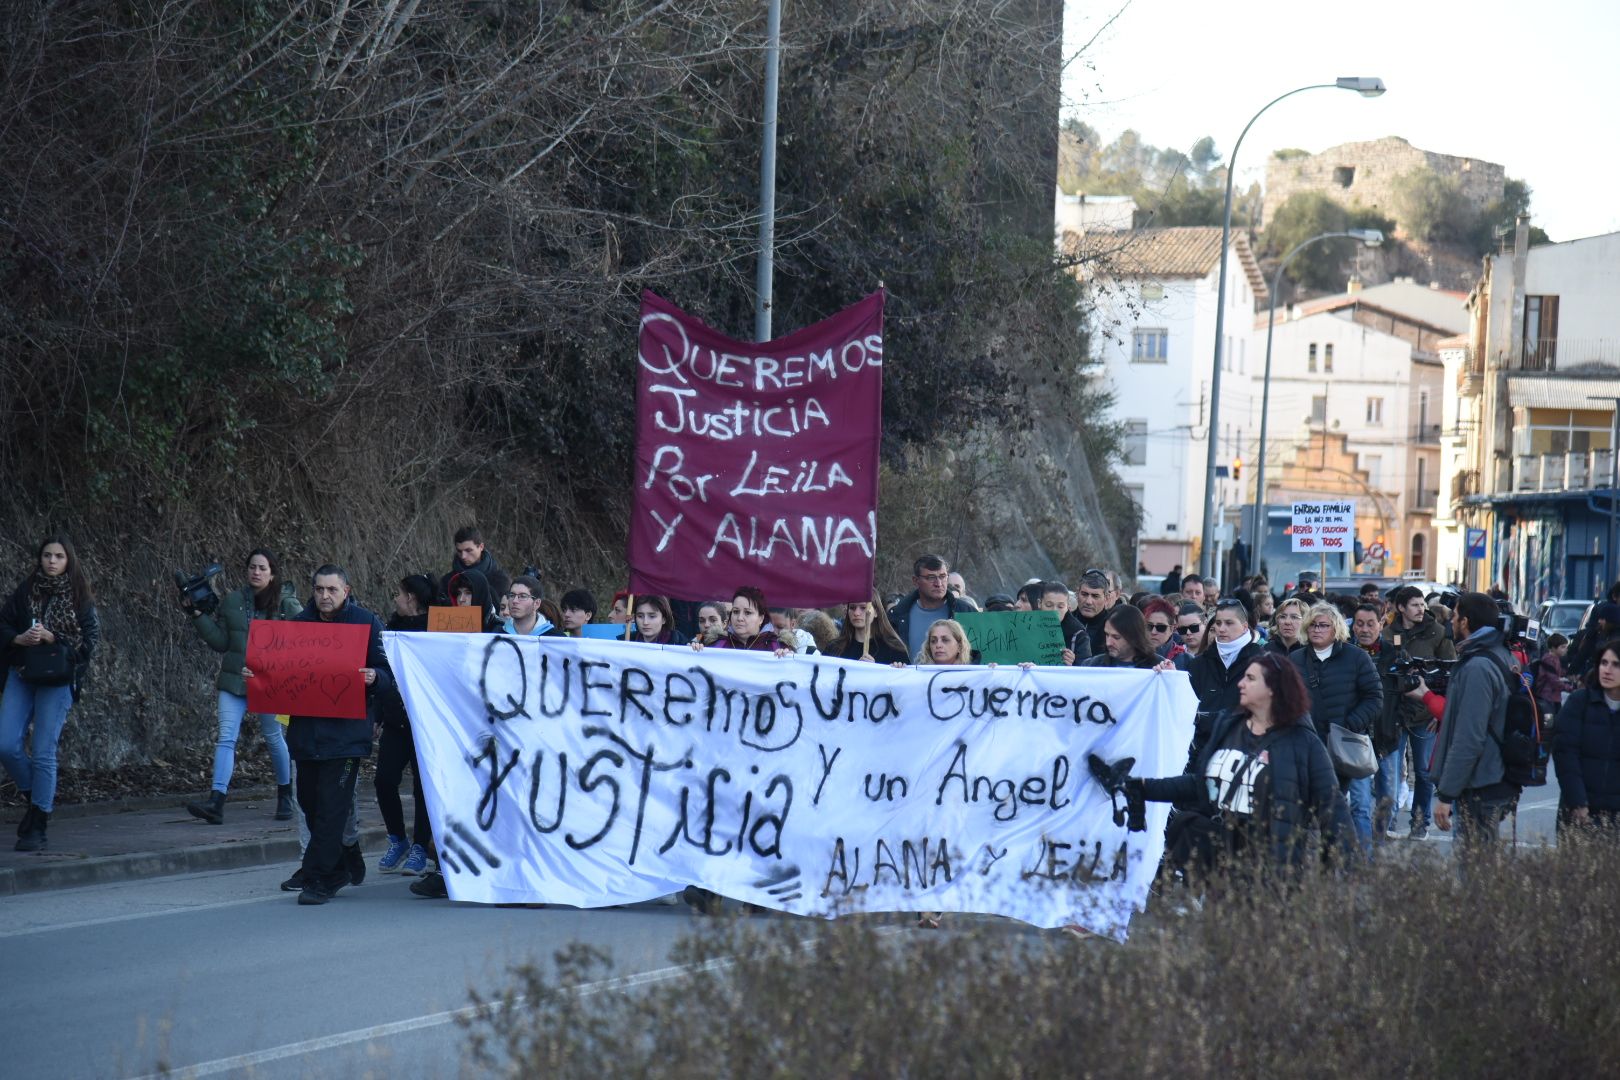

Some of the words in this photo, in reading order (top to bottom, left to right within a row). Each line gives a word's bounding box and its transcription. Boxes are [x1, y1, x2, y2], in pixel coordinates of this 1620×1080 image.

[638, 313, 882, 390] QUEREMOS
[650, 510, 683, 551] Y
[1300, 538, 1314, 547] PARA
[1321, 538, 1343, 548] TODOS
[1315, 526, 1320, 534] Y
[813, 743, 841, 805] Y
[864, 772, 908, 802] un
[936, 743, 1070, 821] Angel
[821, 837, 952, 898] ALANA
